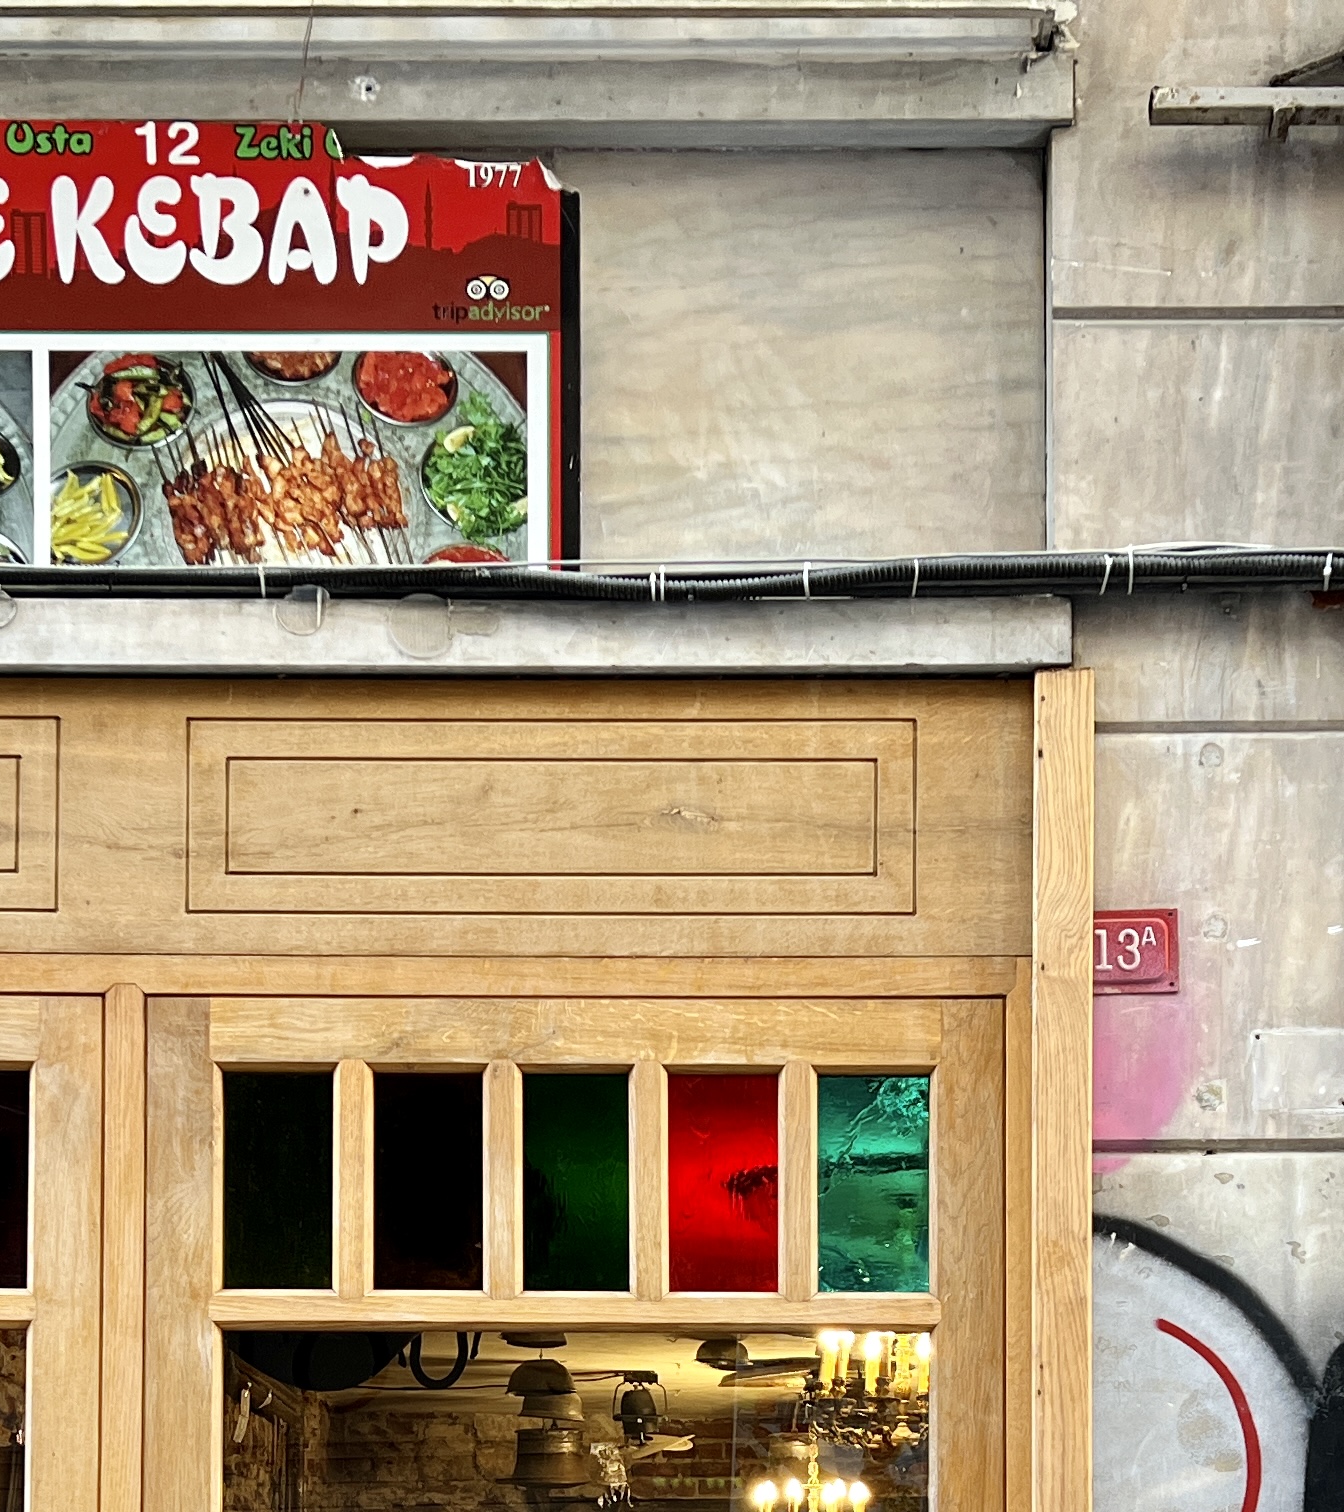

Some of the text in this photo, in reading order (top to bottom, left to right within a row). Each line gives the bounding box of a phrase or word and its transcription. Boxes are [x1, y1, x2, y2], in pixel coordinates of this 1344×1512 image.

[6, 121, 93, 156] Usta
[136, 120, 201, 166] 12
[235, 124, 313, 160] Zeki
[464, 162, 523, 189] 1977
[50, 172, 410, 286] KEBAP
[432, 301, 545, 325] tripadvisor
